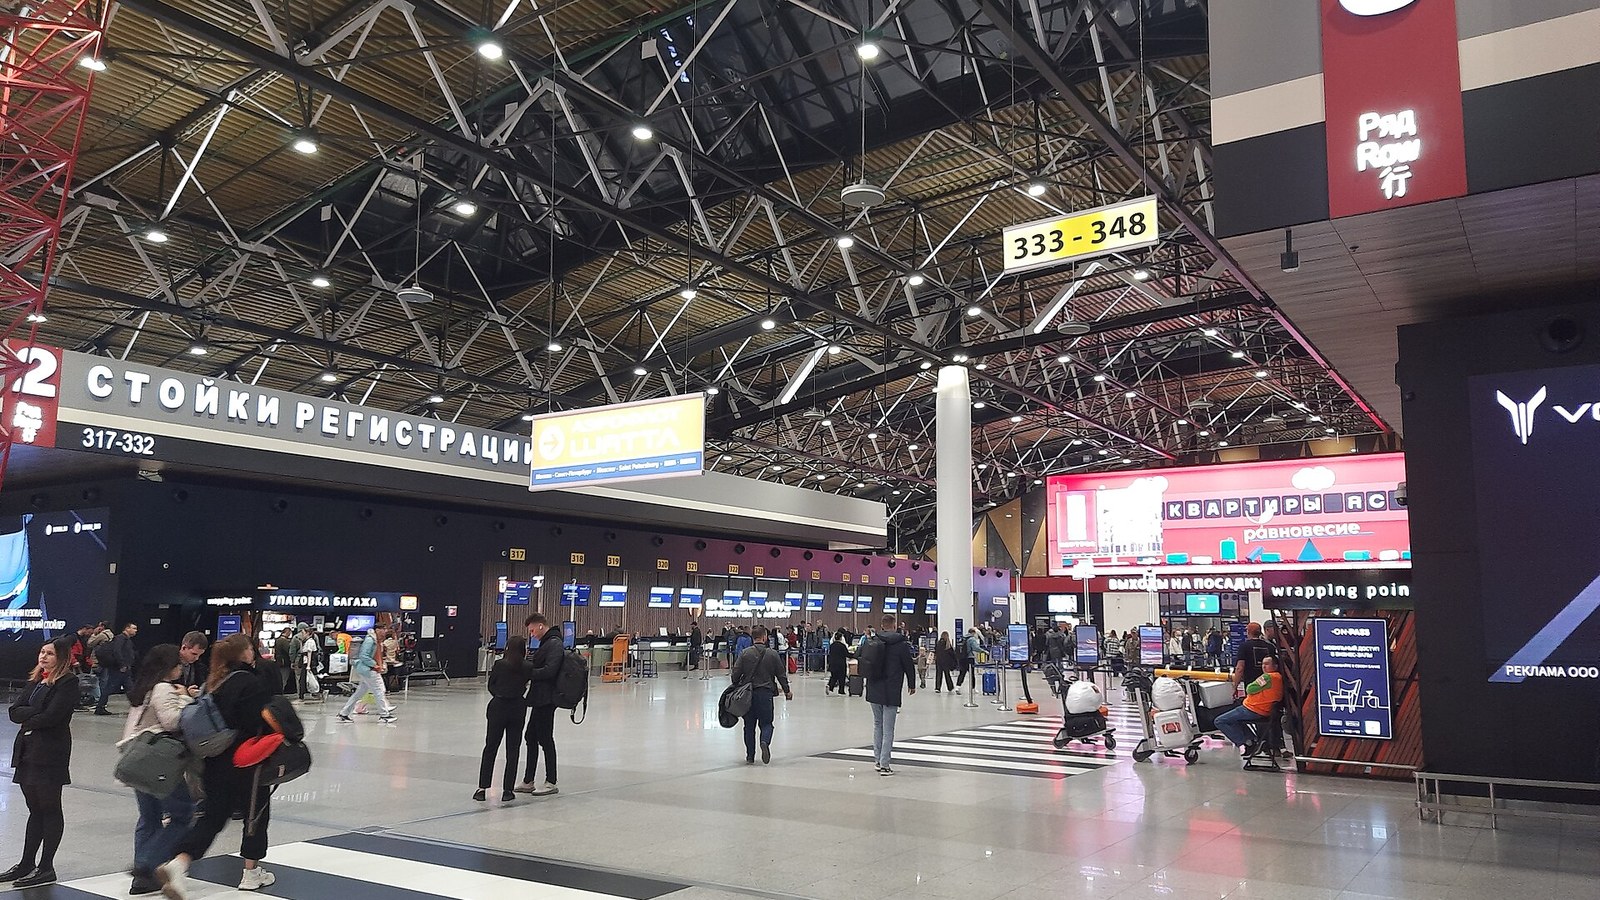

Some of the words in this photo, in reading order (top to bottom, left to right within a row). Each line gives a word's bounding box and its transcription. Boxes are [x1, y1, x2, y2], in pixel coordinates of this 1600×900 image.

[1358, 109, 1417, 142] Ряд
[1356, 138, 1421, 172] Row
[1378, 164, 1413, 200] 行
[1013, 229, 1065, 260] 333
[1090, 211, 1147, 245] 348
[11, 346, 58, 398] 2
[86, 365, 280, 425] СТОЙКИ
[81, 427, 155, 456] 317-332
[1168, 495, 1320, 519] КВАРТИРЫ
[1243, 522, 1361, 544] равновесие
[510, 550, 525, 559] 317
[571, 554, 584, 563] 318
[607, 557, 620, 566] 319
[657, 560, 669, 569] 320
[687, 563, 698, 571] 321
[1171, 578, 1192, 590] НА
[1193, 577, 1263, 592] ПОСАДКУ
[1271, 583, 1358, 599] wrapping
[268, 595, 330, 607] УПАКОВКА
[333, 595, 378, 608] БАГАЖА
[1506, 665, 1567, 677] РЕКЛАМА
[1567, 666, 1599, 678] ООО
